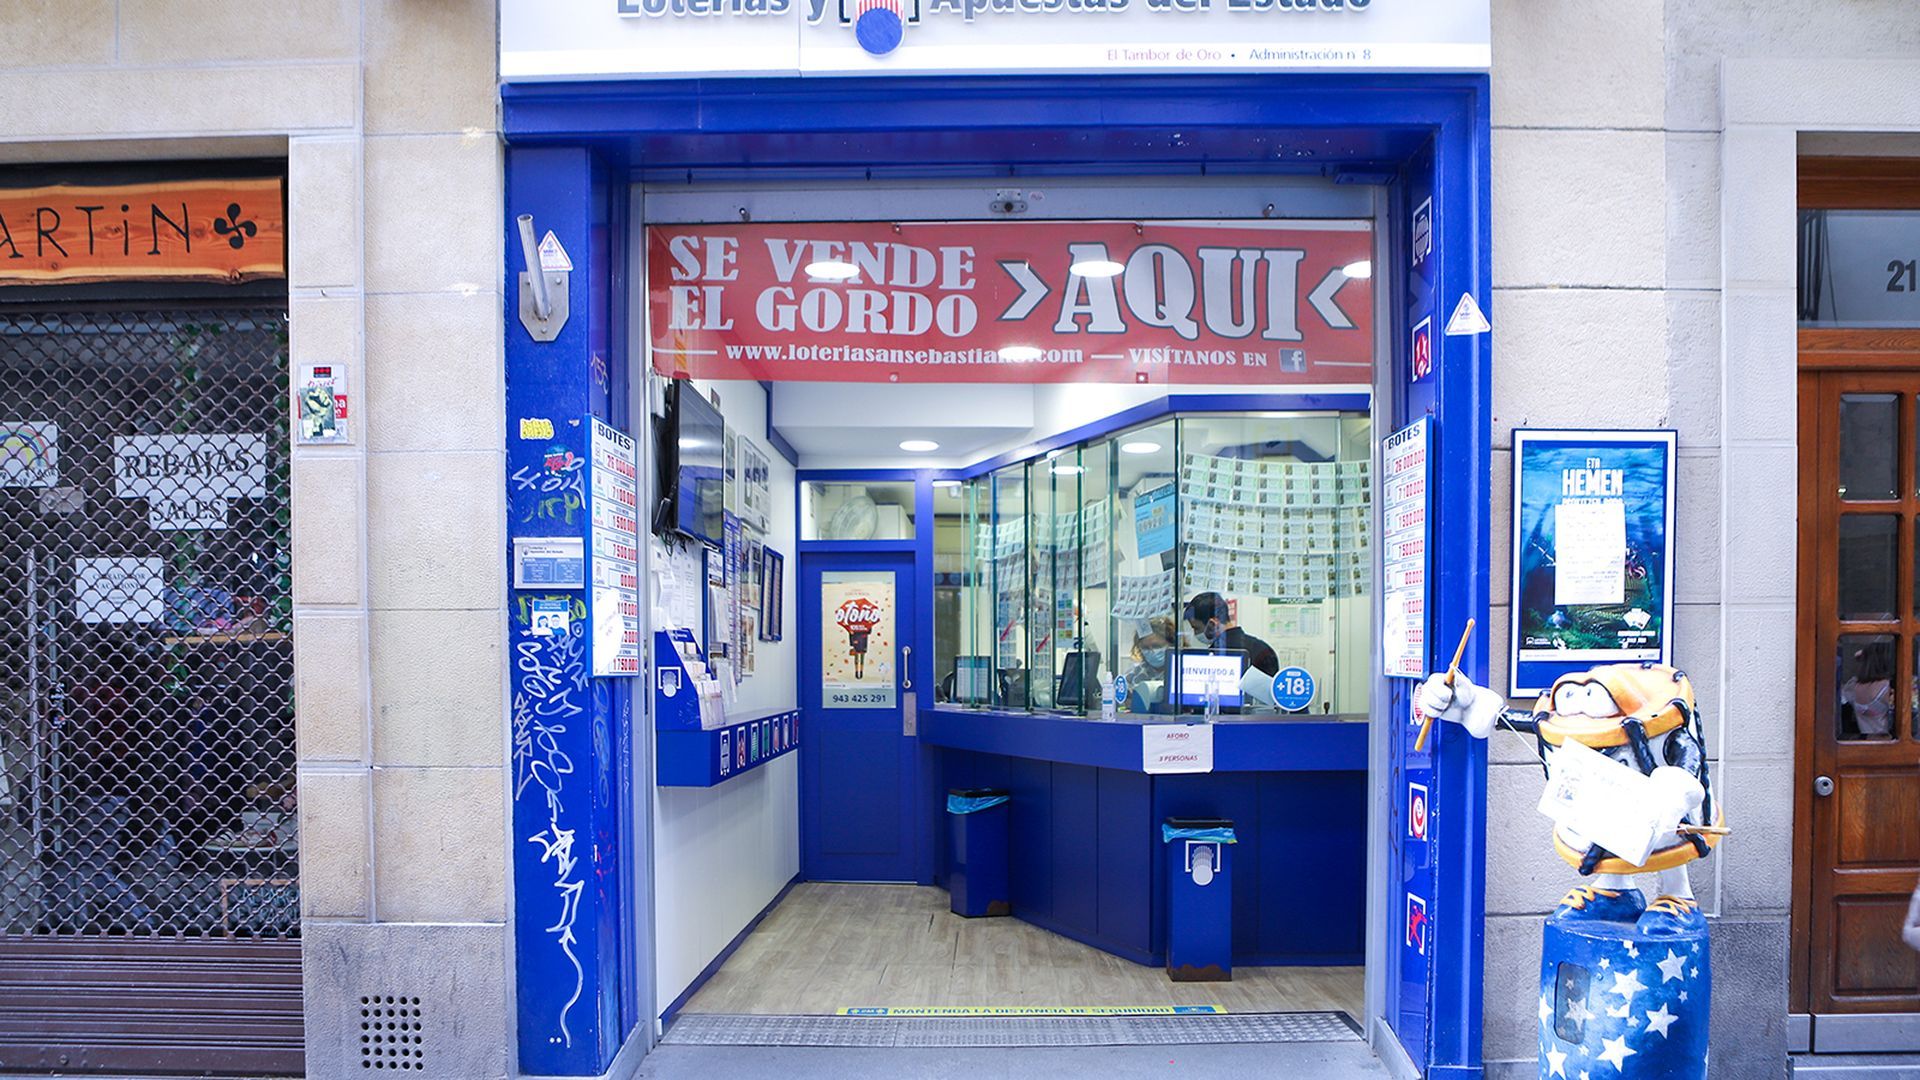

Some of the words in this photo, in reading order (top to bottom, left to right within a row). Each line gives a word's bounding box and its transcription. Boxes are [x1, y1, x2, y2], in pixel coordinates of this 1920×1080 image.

[1107, 48, 1118, 61] El
[1123, 48, 1171, 61] Tambor
[1176, 48, 1193, 61] de
[1196, 48, 1222, 61] Oro
[1249, 47, 1344, 61] Administración
[1362, 49, 1372, 61] 8
[668, 235, 740, 281] SE
[764, 238, 977, 290] VENDE
[1886, 259, 1917, 292] 21
[1053, 242, 1306, 341] AQUI
[668, 286, 735, 331] EL
[755, 287, 979, 337] GORDO
[725, 344, 1084, 367] www.loteriasansebastia.com
[1129, 346, 1237, 366] VISÍTANOS
[1242, 351, 1268, 367] EN
[597, 423, 631, 450] BOTES
[1387, 424, 1421, 450] BOTES
[124, 450, 250, 479] REBAJAS
[1562, 469, 1624, 496] HEMEN
[150, 501, 223, 521] SALES
[833, 694, 848, 703] 943
[852, 694, 868, 703] 425
[871, 694, 886, 703] 291
[1277, 677, 1305, 696] +18
